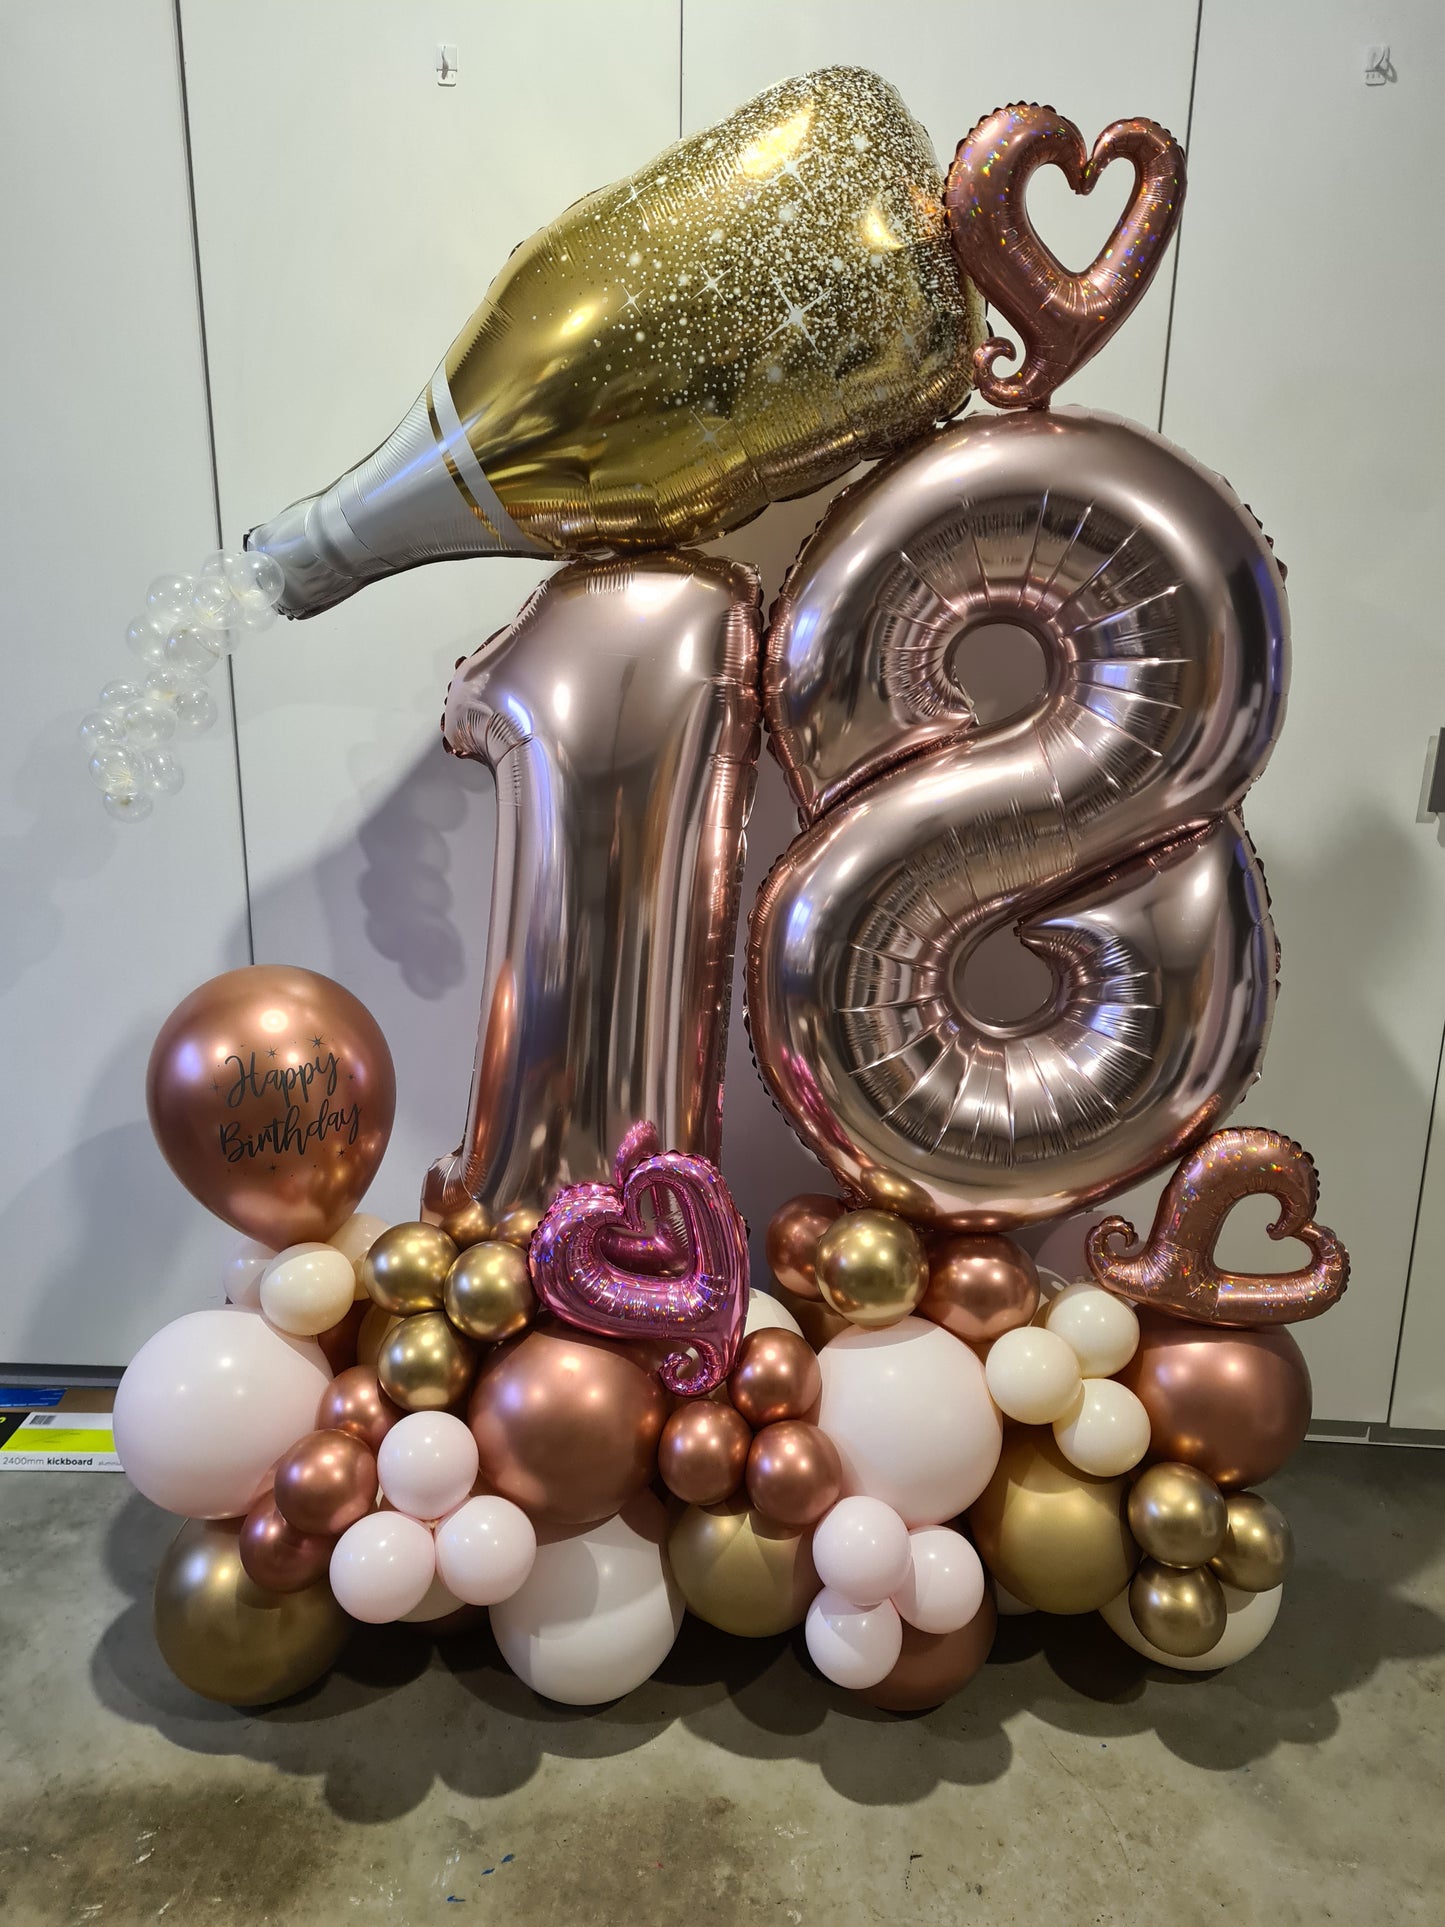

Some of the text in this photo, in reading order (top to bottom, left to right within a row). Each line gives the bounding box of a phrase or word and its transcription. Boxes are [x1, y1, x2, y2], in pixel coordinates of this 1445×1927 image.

[225, 1052, 339, 1108] Happy
[220, 1099, 361, 1162] Birthday
[3, 1457, 44, 1465] 2400mm
[47, 1458, 93, 1466] kickboard
